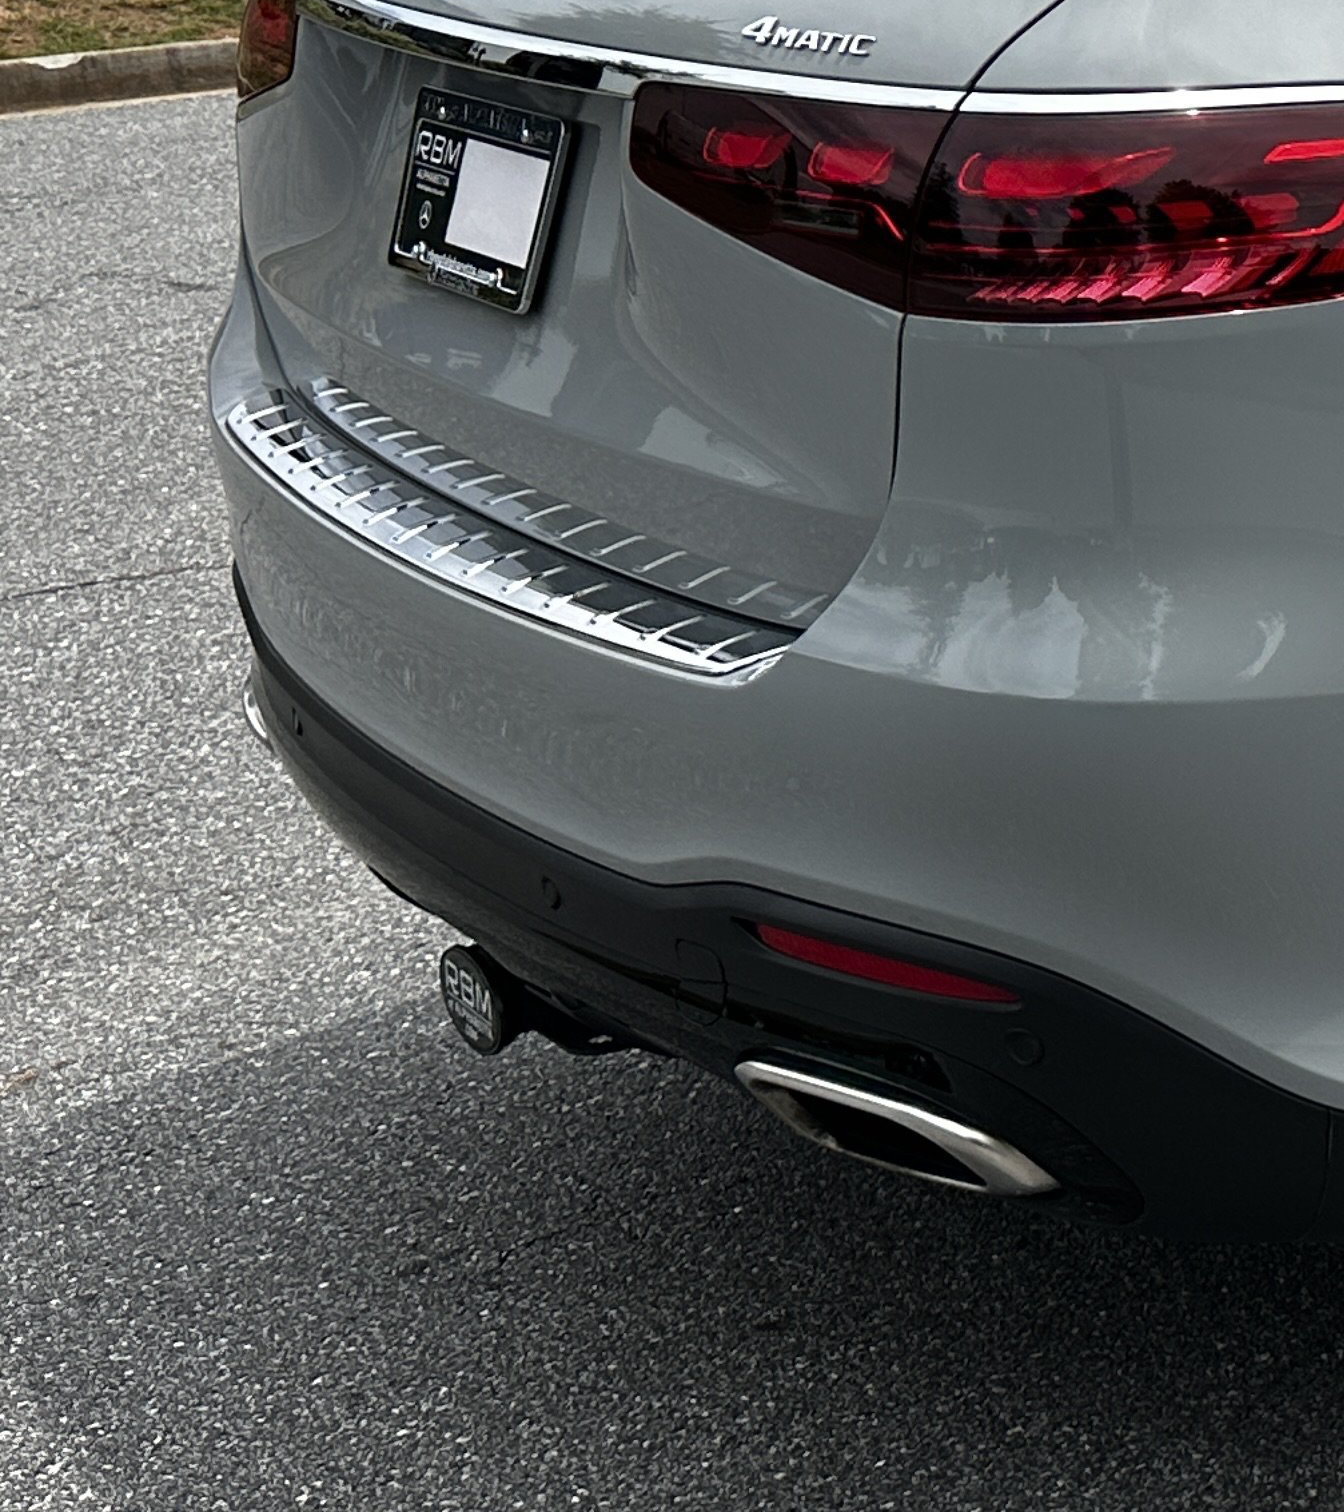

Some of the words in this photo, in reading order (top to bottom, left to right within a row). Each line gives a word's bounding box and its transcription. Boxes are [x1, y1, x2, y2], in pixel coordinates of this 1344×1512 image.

[741, 16, 877, 56] 4MATIC
[416, 130, 462, 170] RBM
[444, 958, 493, 1022] RBM
